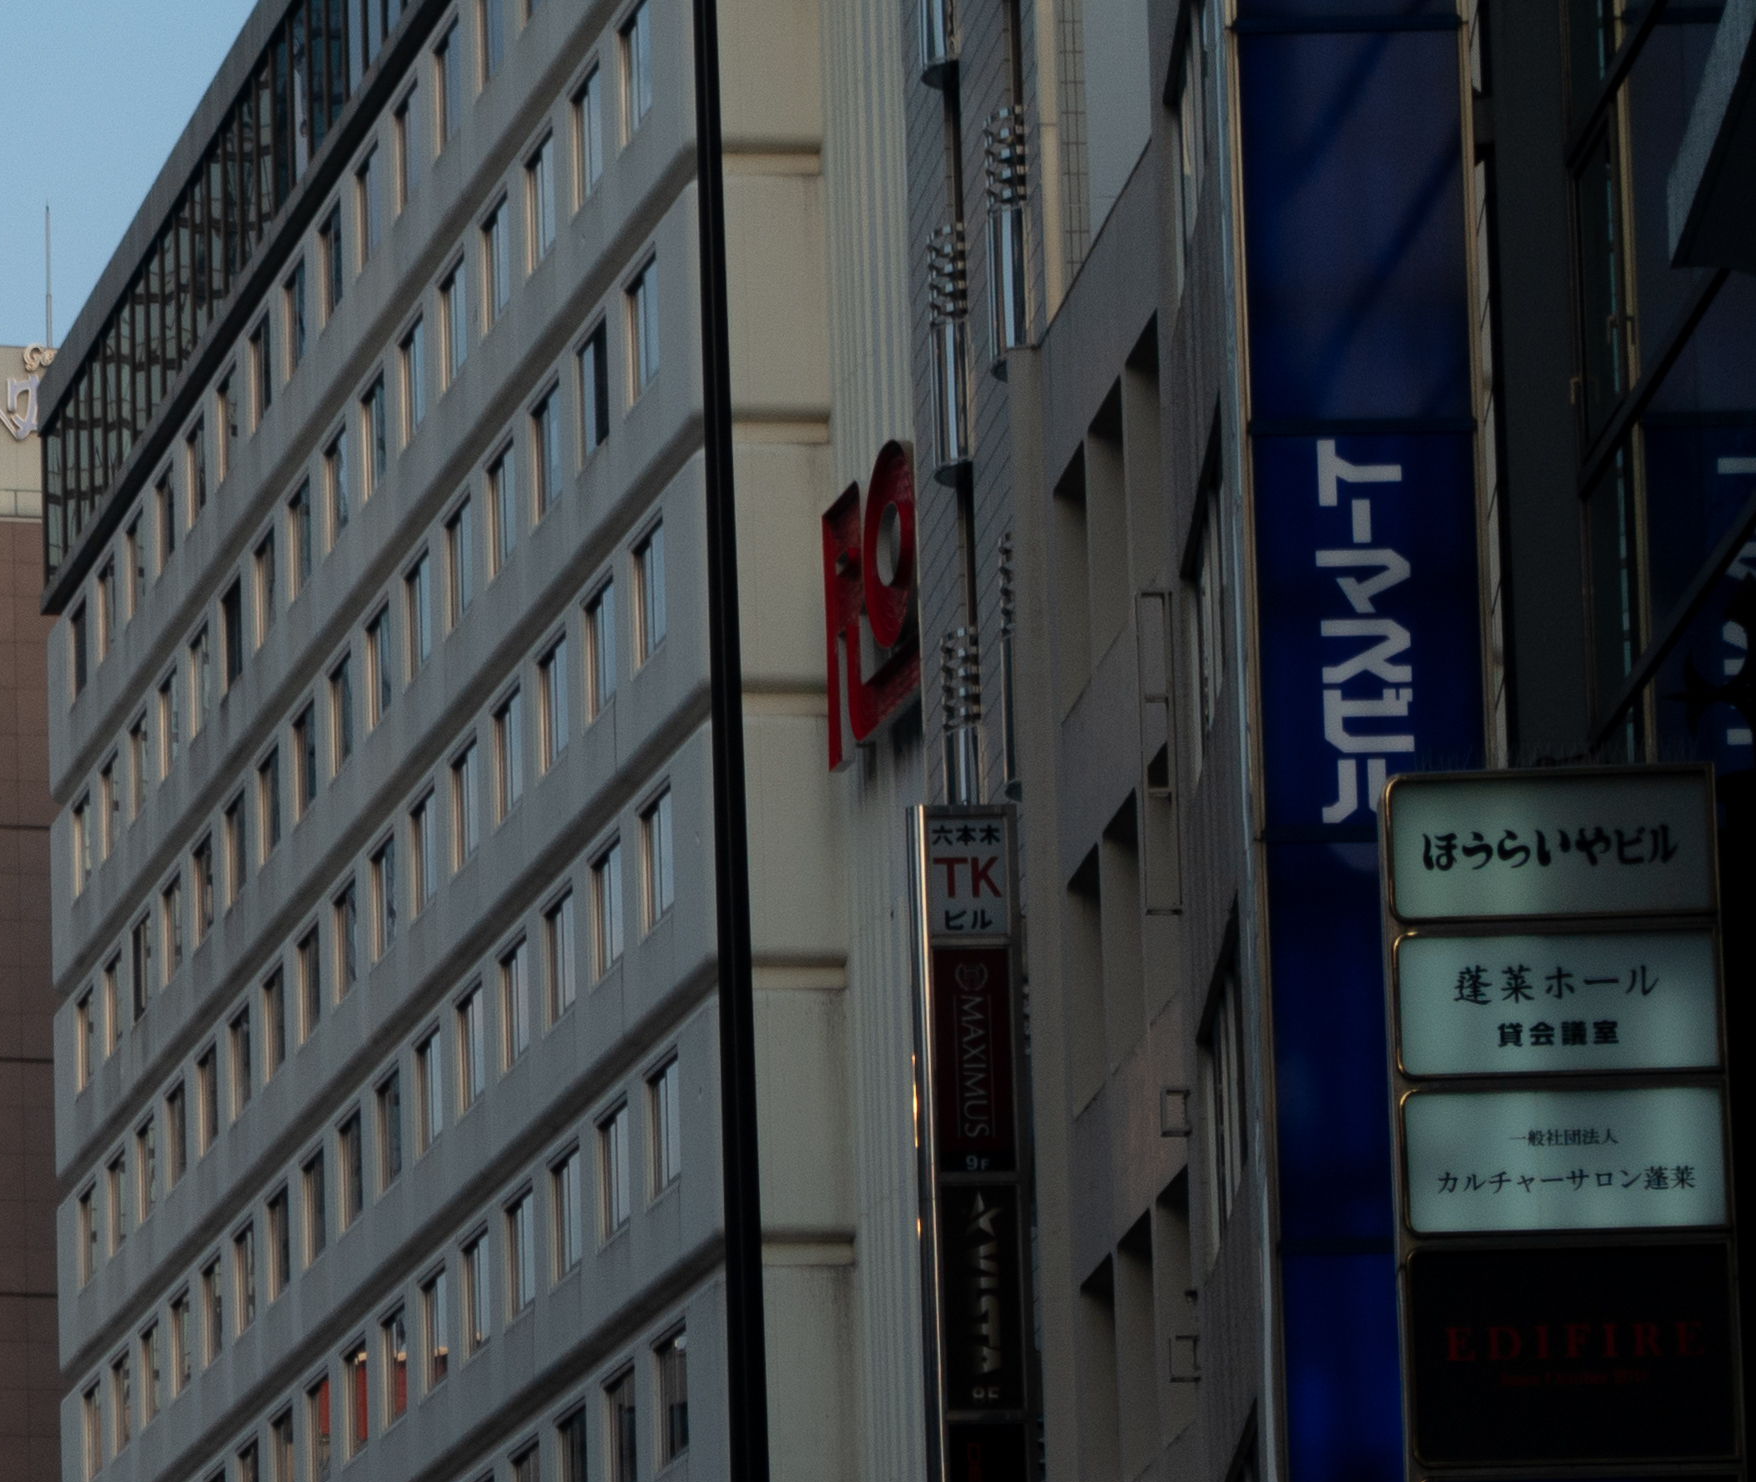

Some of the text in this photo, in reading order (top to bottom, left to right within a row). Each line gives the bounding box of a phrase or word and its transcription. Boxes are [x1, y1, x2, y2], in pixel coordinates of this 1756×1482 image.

[1315, 438, 1416, 824] トーマスビル
[932, 824, 1001, 846] 六本木
[1422, 823, 1679, 871] ほうらいやビル
[933, 856, 1002, 899] TK
[944, 909, 993, 931] ビル
[1453, 964, 1659, 1005] 蓬莱ホール
[1497, 1020, 1620, 1047] 貸会議室
[960, 995, 990, 1138] MAXIMUS
[1508, 1128, 1619, 1147] 一般社団法人
[965, 1155, 990, 1171] 9F
[1437, 1165, 1696, 1195] カルチャーサロン蓬莱
[1445, 1321, 1706, 1362] EDIFIRE
